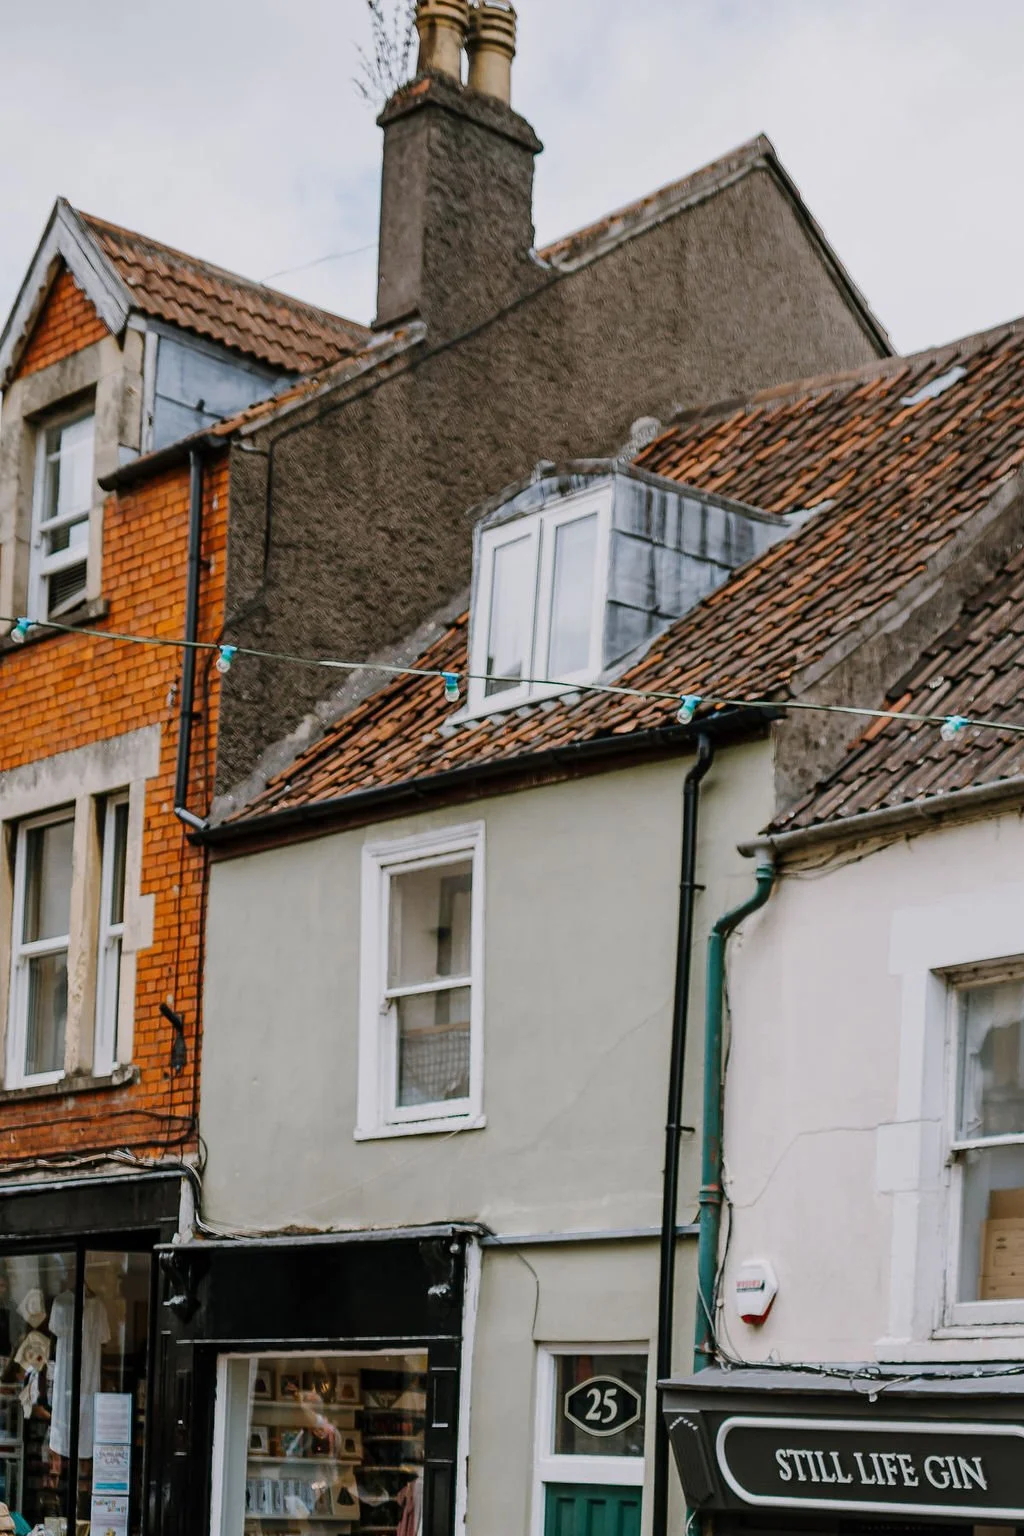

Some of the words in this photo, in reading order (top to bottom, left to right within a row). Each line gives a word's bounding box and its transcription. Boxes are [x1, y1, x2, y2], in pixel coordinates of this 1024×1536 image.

[585, 1388, 617, 1423] 25
[775, 1448, 854, 1484] STILL
[853, 1452, 919, 1487] LIFE
[924, 1455, 988, 1491] GIN
